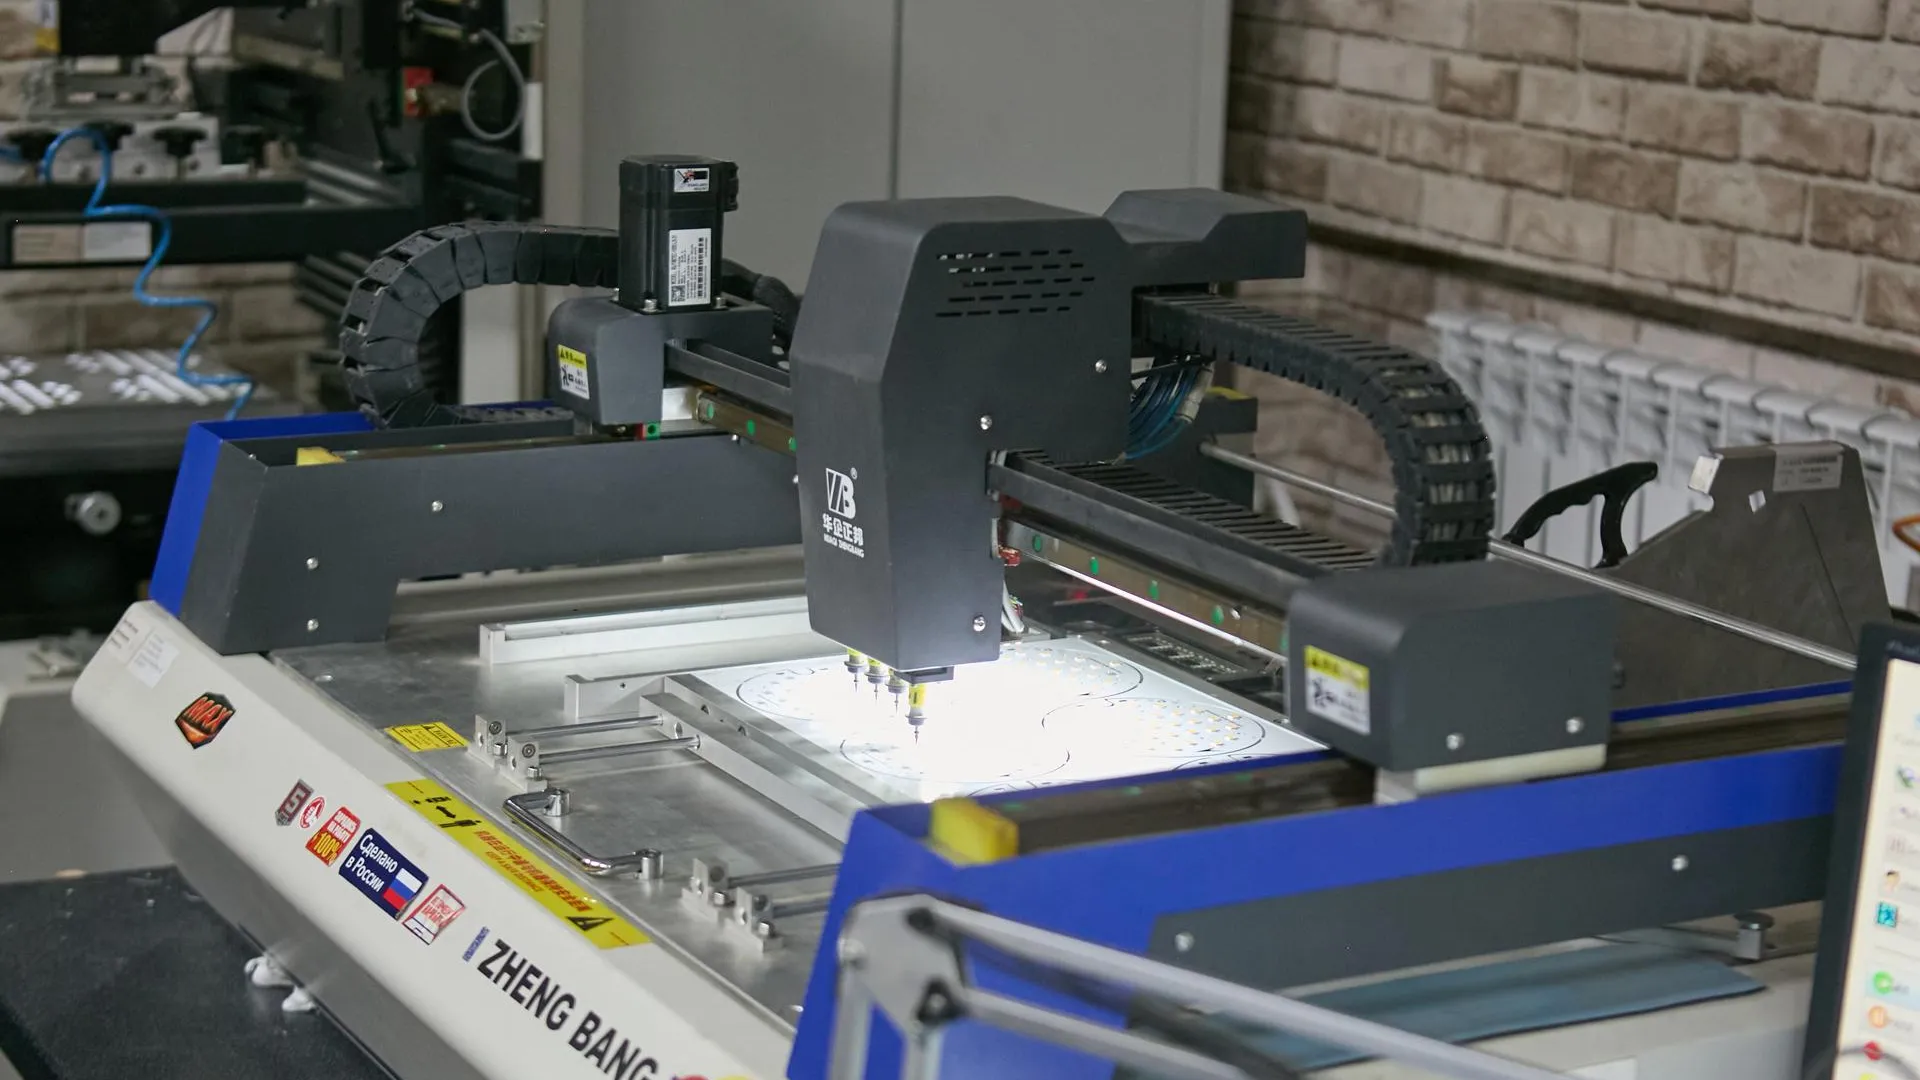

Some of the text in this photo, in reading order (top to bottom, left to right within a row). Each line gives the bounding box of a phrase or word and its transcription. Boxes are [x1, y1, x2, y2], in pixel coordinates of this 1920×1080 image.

[359, 834, 399, 873] Сделано
[345, 856, 385, 892] в России
[477, 938, 576, 1031] ZHENG
